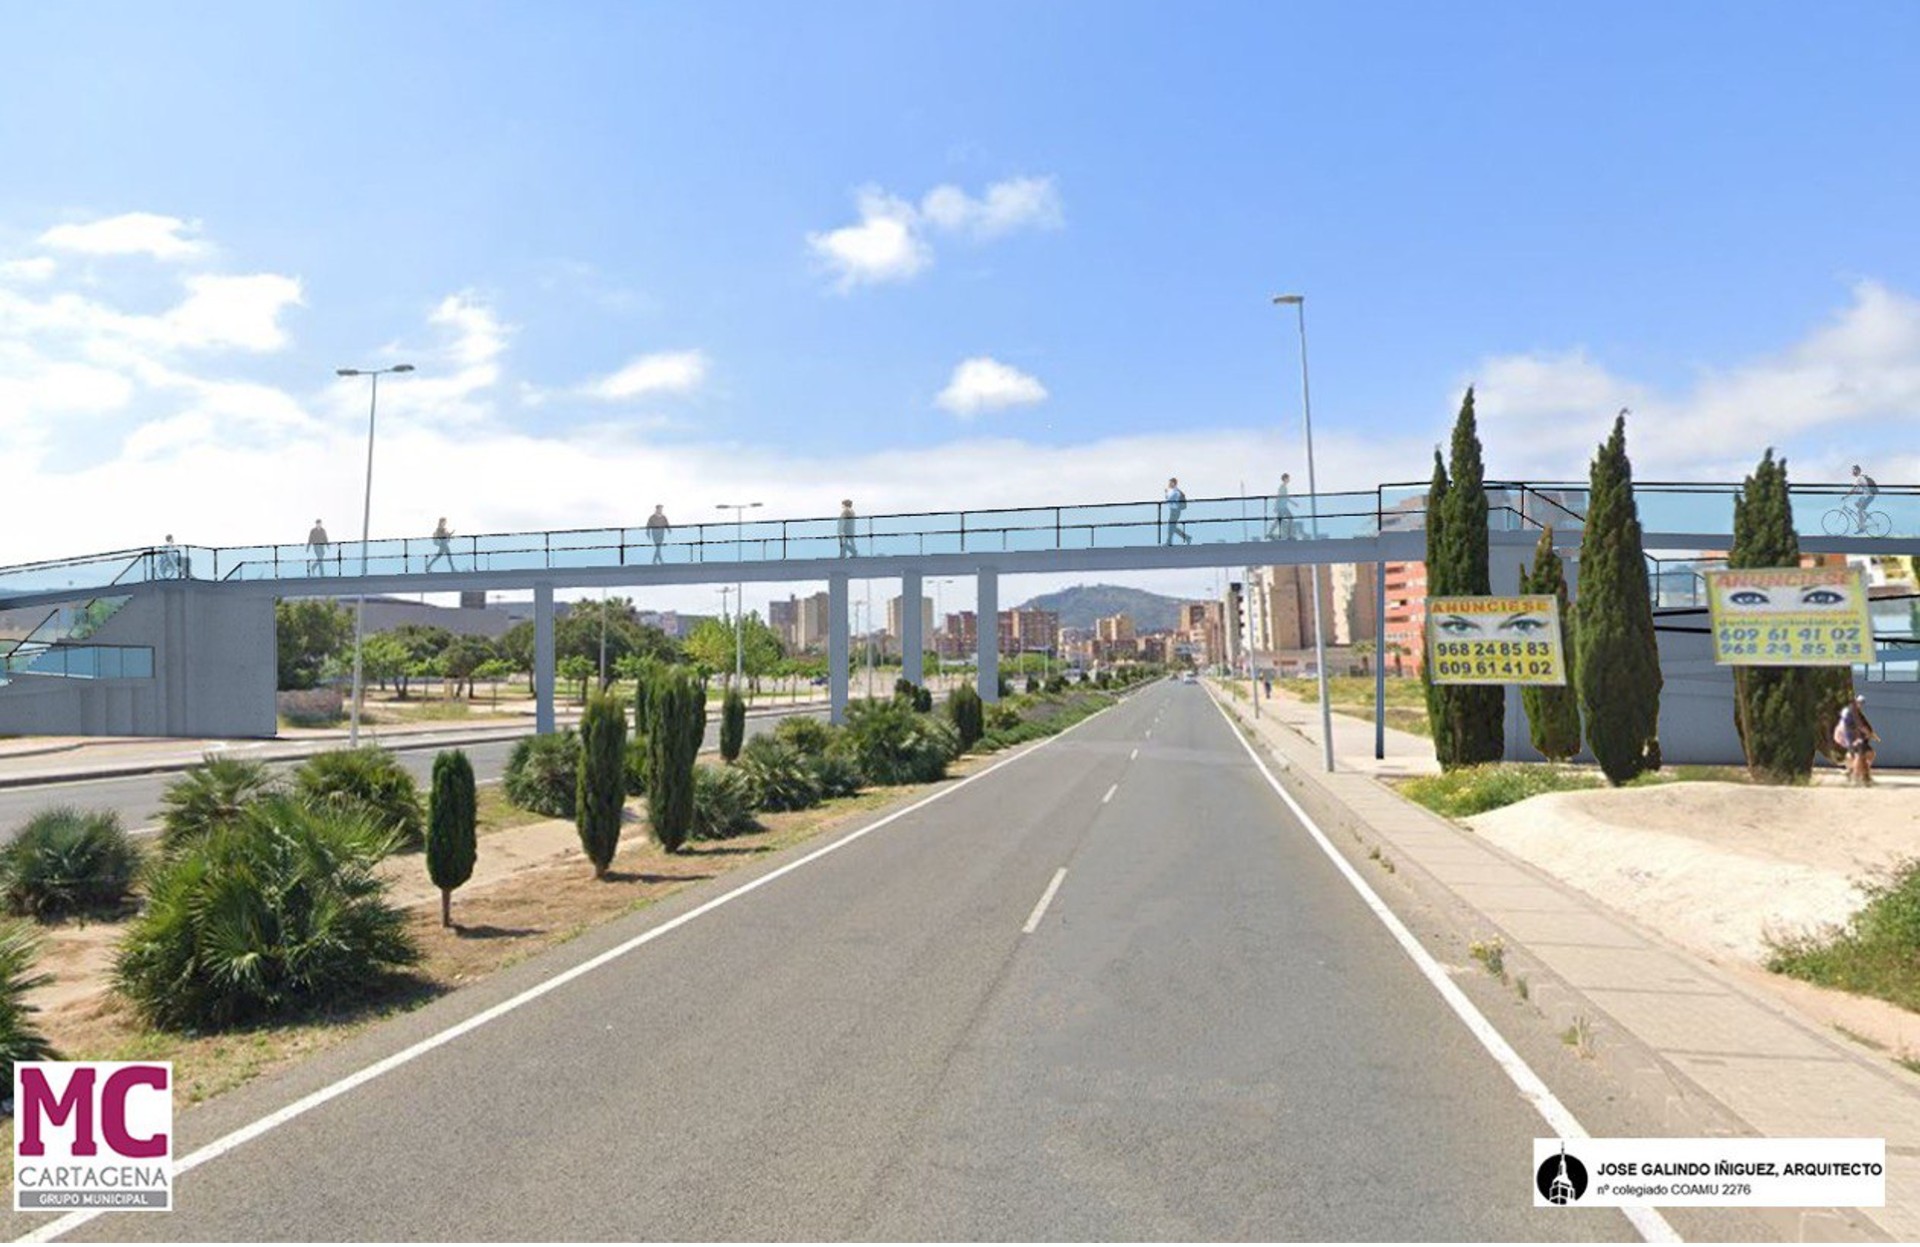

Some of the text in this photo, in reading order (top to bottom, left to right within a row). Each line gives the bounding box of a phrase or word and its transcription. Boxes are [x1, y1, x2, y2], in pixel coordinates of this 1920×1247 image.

[1719, 628, 1759, 641] 609
[1768, 628, 1790, 641] 61
[1830, 627, 1861, 641] 02
[1437, 642, 1550, 656] 968 24 85 83
[1720, 643, 1758, 655] 968
[1801, 643, 1826, 655] 85
[1440, 661, 1553, 675] 609 61 41 02
